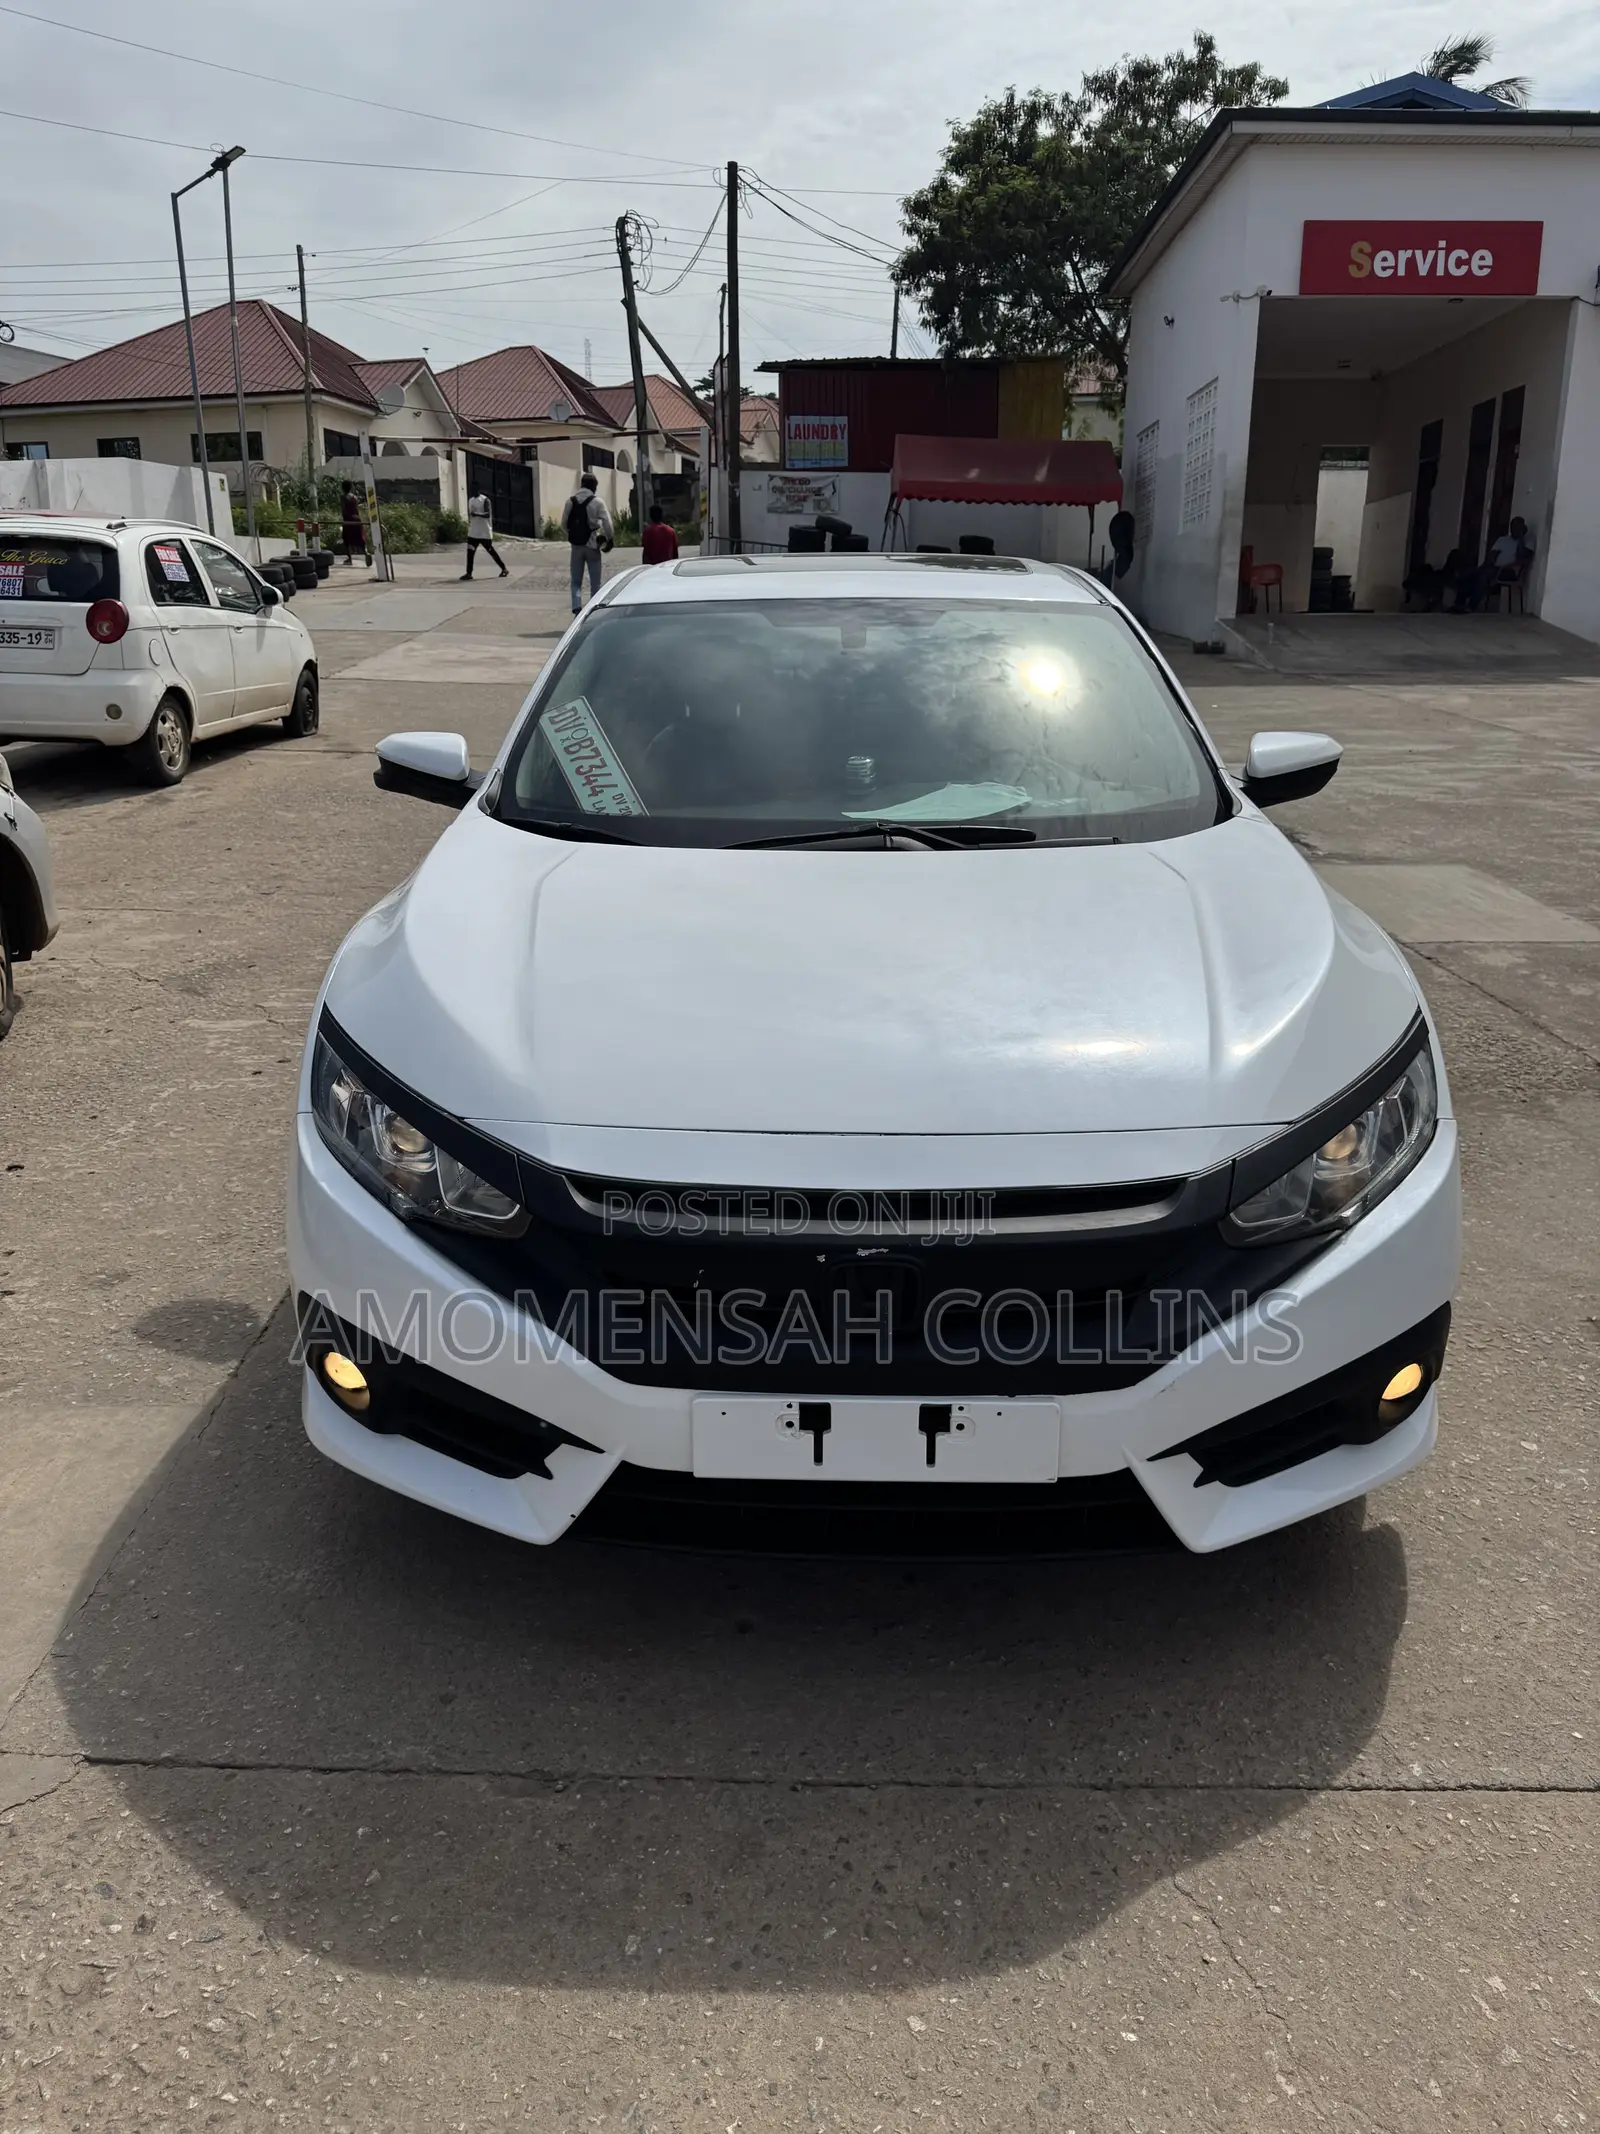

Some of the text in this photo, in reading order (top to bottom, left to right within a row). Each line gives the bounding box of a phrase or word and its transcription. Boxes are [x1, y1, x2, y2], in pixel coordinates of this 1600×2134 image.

[1348, 240, 1494, 278] Service
[787, 423, 847, 440] LAUNDRY
[0, 565, 25, 576] SALE
[0, 578, 22, 587] 6807
[0, 631, 42, 645] 335-19
[548, 706, 586, 734] DV
